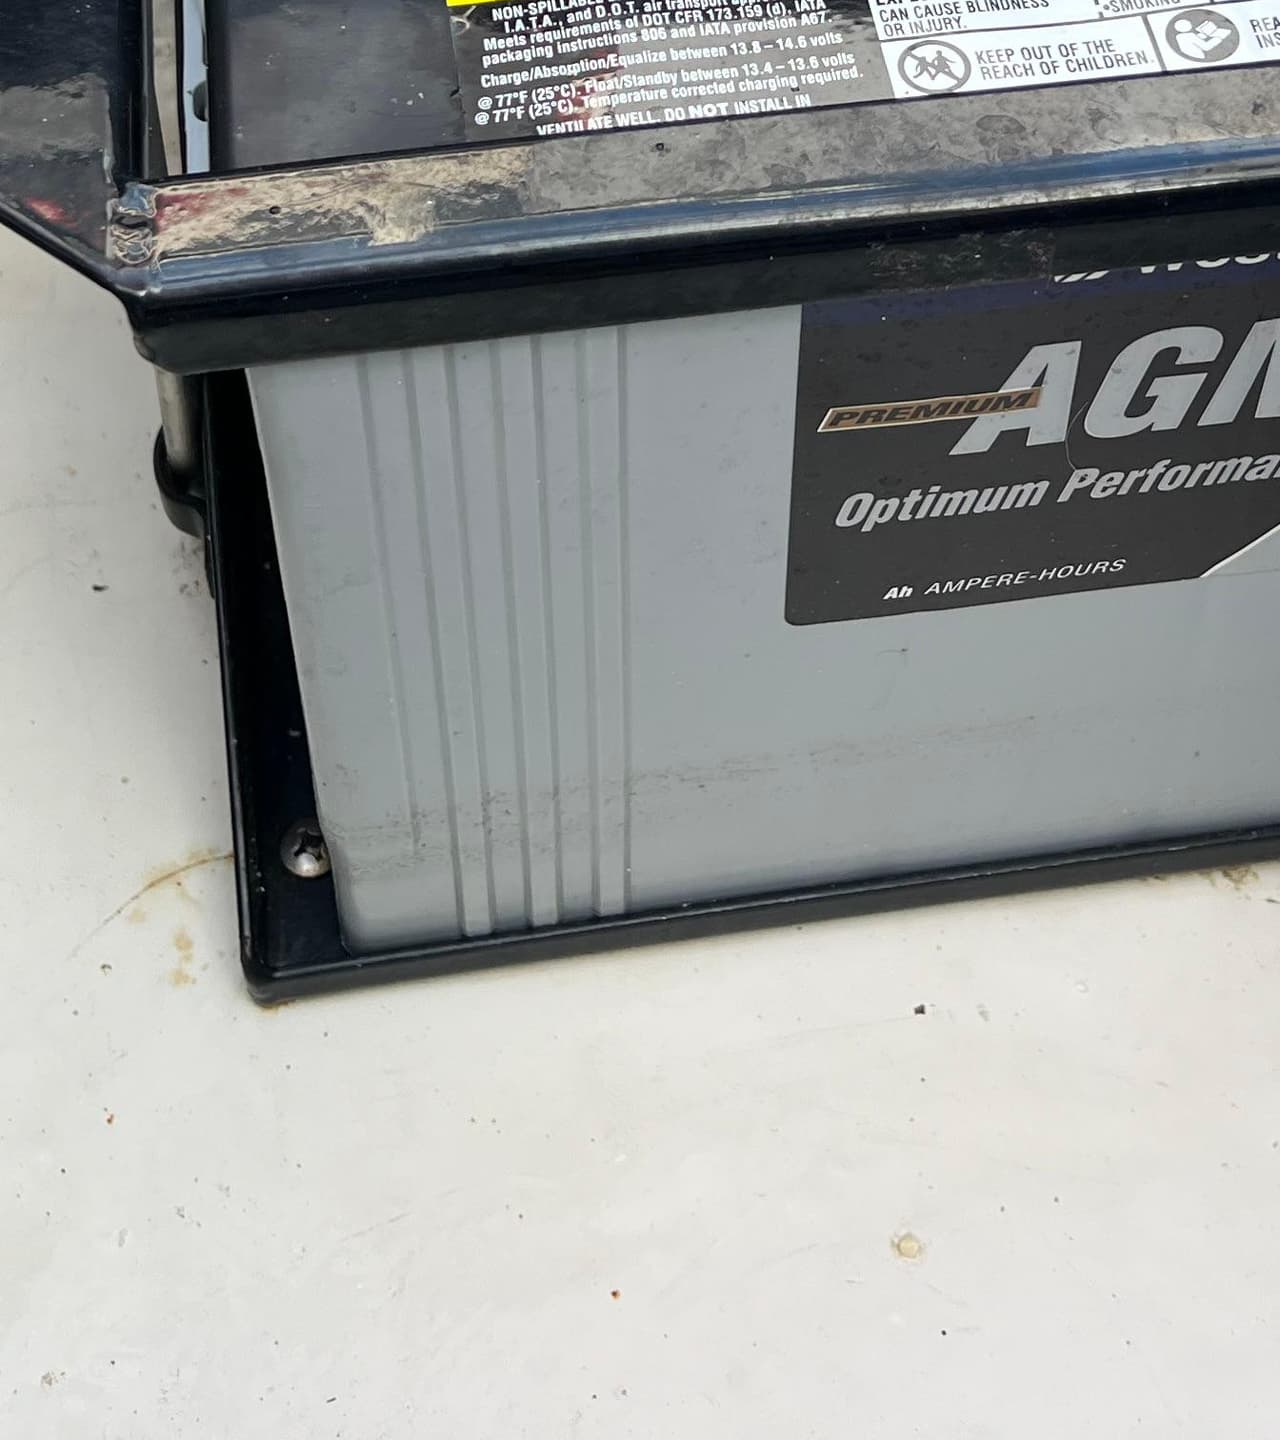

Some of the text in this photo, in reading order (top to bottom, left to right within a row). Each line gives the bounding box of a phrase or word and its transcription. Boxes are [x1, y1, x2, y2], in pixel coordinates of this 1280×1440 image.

[484, 33, 527, 51] Meets
[530, 20, 621, 46] requirements
[625, 15, 638, 29] of
[642, 12, 670, 27] DOT
[675, 9, 704, 24] CFR
[709, 4, 763, 21] 173.159
[567, 8, 592, 24] and
[596, 1, 639, 18] D.O.T.
[643, 0, 662, 13] air
[879, 7, 909, 23] CAN
[914, 2, 962, 19] CAUSE
[883, 16, 968, 37] OR INJURY.
[480, 32, 843, 88] Charge/Absorption/Equalize between 13.8 14.6 volts
[482, 16, 797, 68] packaging instructions 806 and IATA provision
[975, 38, 1115, 65] KEEP OUT OF THE
[585, 52, 855, 94] Float/Standby between 13.4 13.6 volts
[979, 50, 1155, 80] REACH OF CHILDREN.
[582, 66, 864, 110] Temperature corrected charging required.
[665, 93, 811, 121] DO NOT INSTALL IN
[826, 391, 1037, 428] PREMIUM
[835, 479, 1050, 532] Optimum
[883, 559, 1126, 601] Ah AMPERE-HOURS
